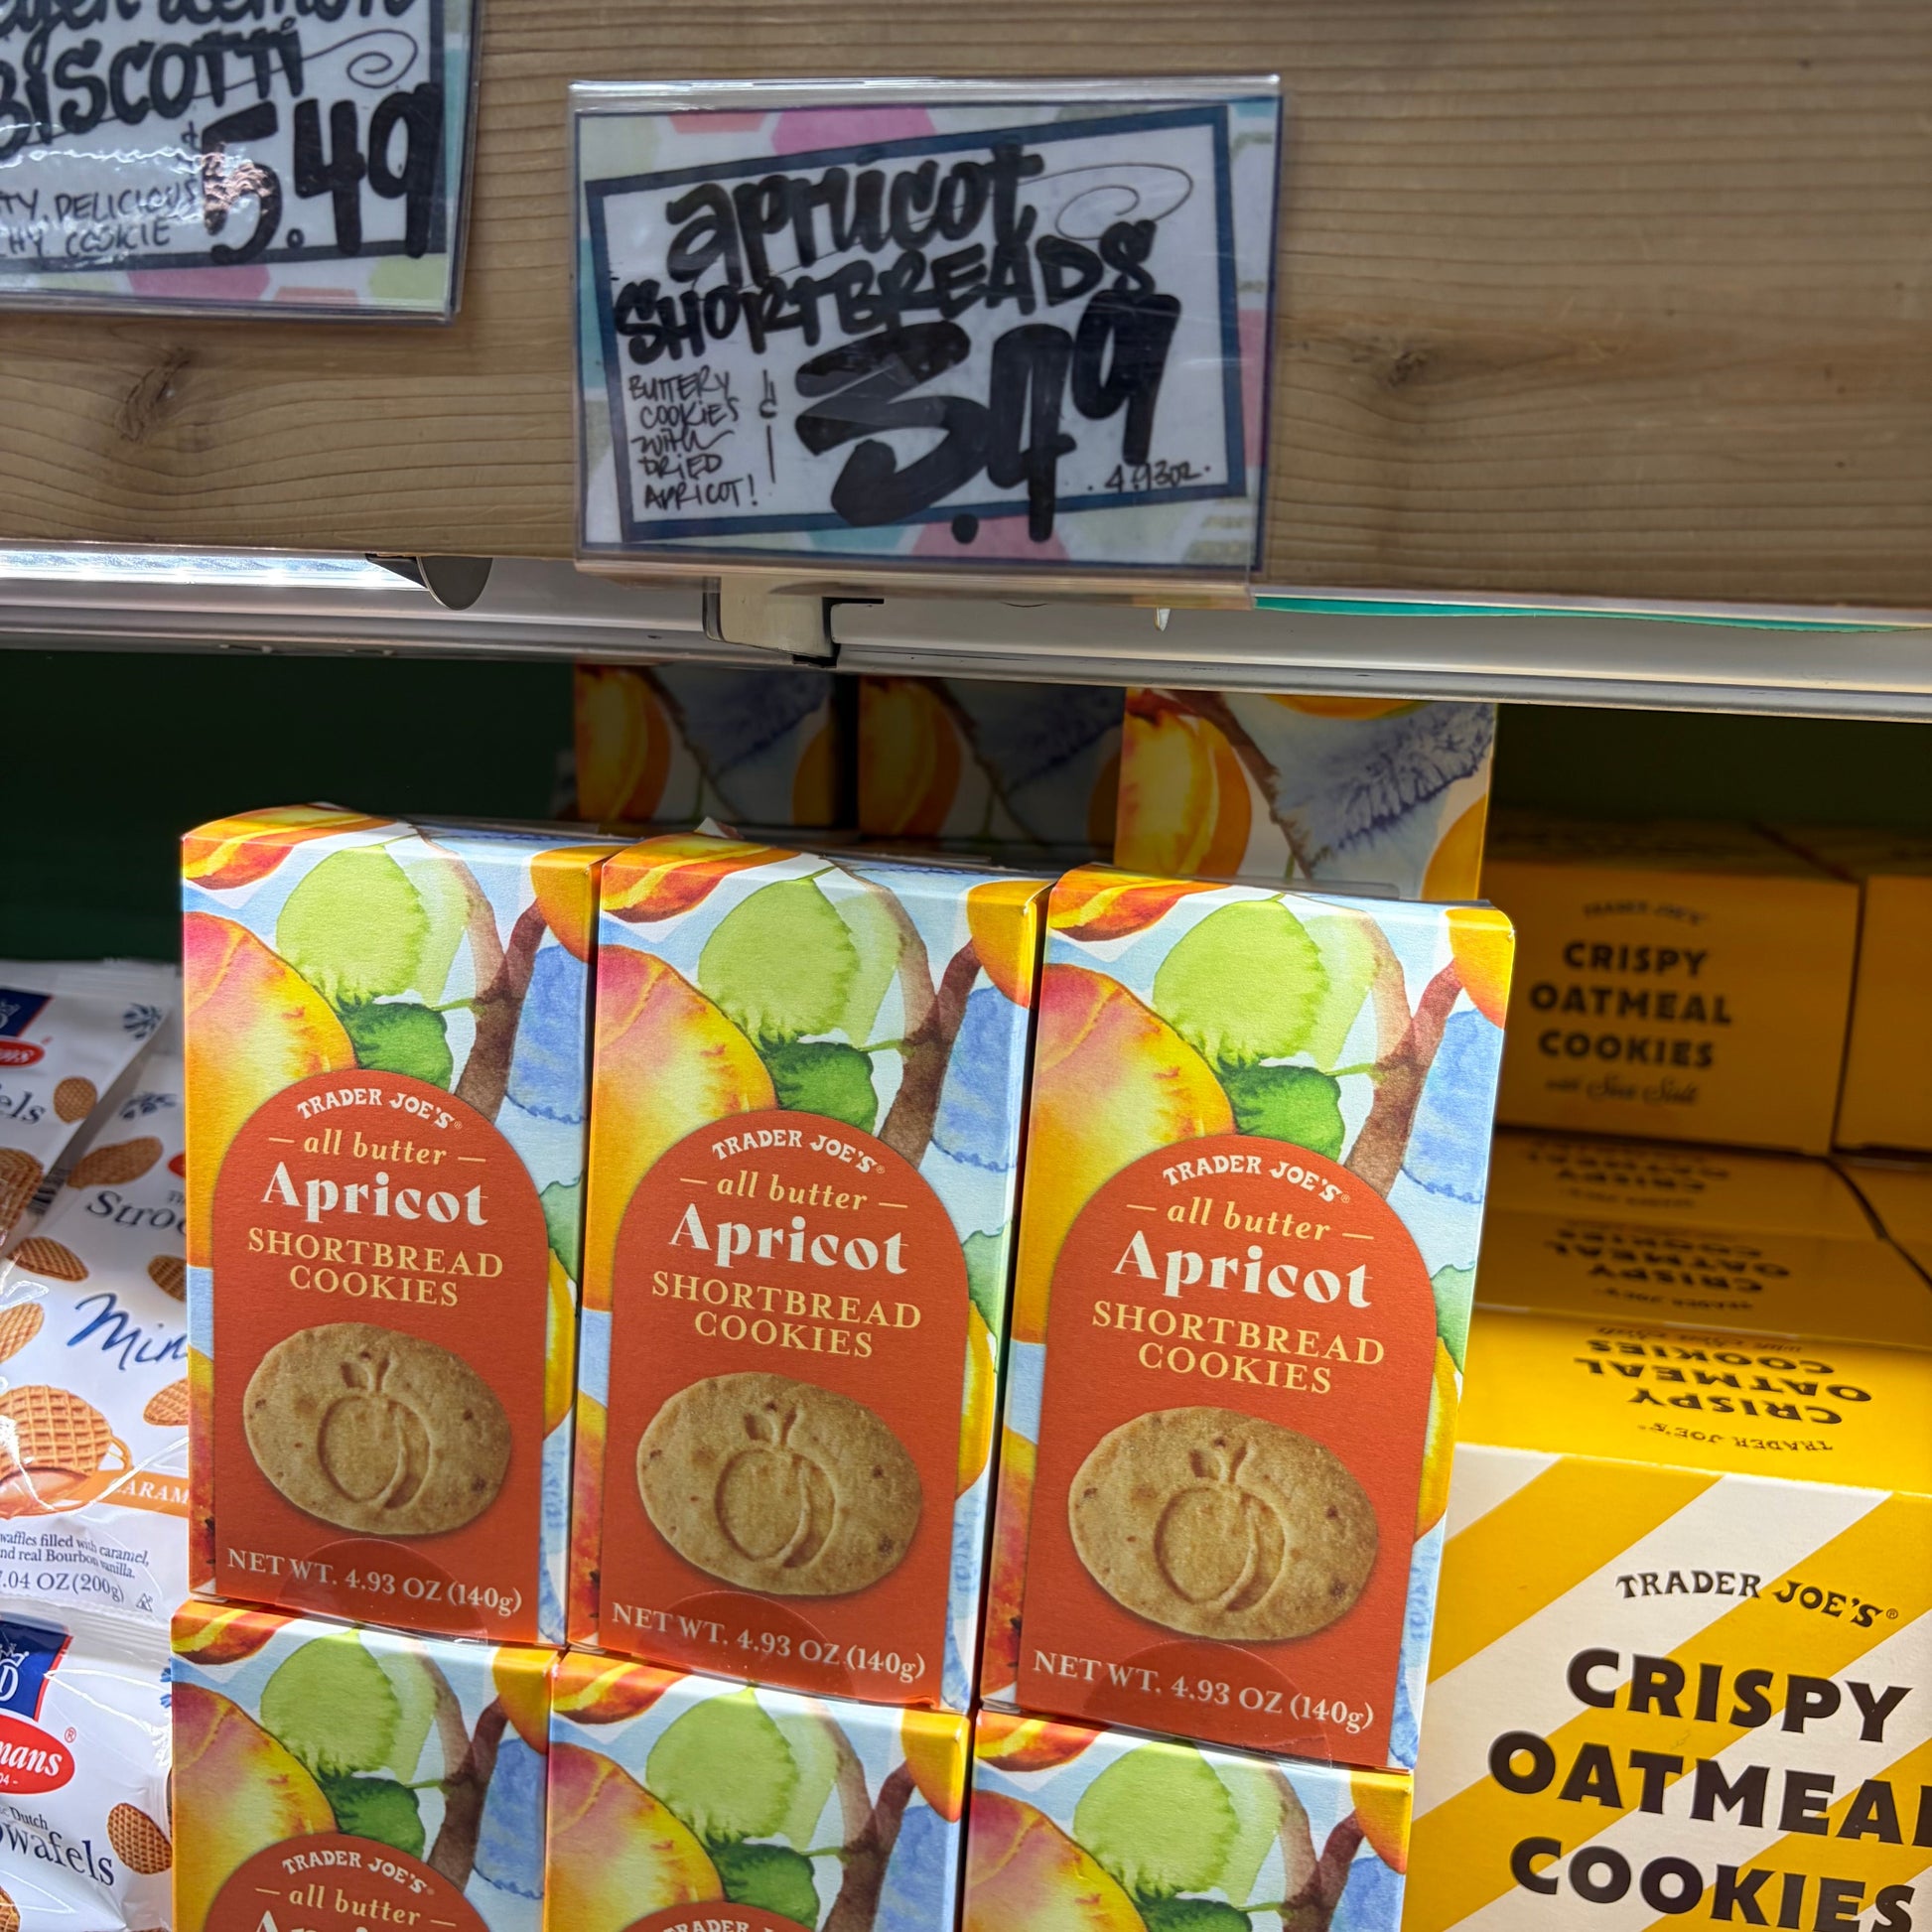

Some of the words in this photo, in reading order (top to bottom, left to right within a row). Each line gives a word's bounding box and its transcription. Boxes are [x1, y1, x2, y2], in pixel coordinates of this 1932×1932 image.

[66, 215, 170, 258] COOKIE
[629, 364, 730, 402] BUTTERY
[1564, 940, 1710, 976] CRISPY
[1529, 983, 1732, 1026] OATMEAL
[1538, 1030, 1716, 1069] COOKIES
[297, 1088, 382, 1121] TRADER
[304, 1129, 342, 1155] all
[353, 1132, 446, 1165] butter
[712, 1130, 802, 1161] TRADER
[717, 1171, 758, 1197] all
[769, 1174, 867, 1210] butter
[1163, 1155, 1262, 1186] TRADER
[261, 1162, 488, 1226] Apricot
[668, 1203, 908, 1275] Apricot
[1167, 1196, 1212, 1226] all
[1223, 1201, 1331, 1241] butter
[248, 1227, 503, 1279] SHORTBREAD
[1112, 1229, 1373, 1309] Apricot
[289, 1265, 458, 1308] COOKIES
[651, 1271, 921, 1329] SHORTBREAD
[694, 1311, 873, 1358] COOKIES
[1092, 1301, 1385, 1366] SHORTBREAD
[1138, 1342, 1331, 1394] COOKIES
[1587, 1339, 1835, 1374] COOKIES
[1574, 1357, 1871, 1402] OATMEAL
[1627, 1388, 1843, 1425] CRISPY
[1733, 1437, 1833, 1451] TRADER
[19, 1550, 42, 1562] real
[46, 1549, 99, 1567] Bourbon
[41, 1534, 73, 1547] filled
[76, 1539, 97, 1553] with
[227, 1548, 285, 1575] NET
[289, 1559, 338, 1586] WT.
[345, 1569, 395, 1594] 4.93
[403, 1577, 442, 1601] OZ
[447, 1581, 522, 1616] (140g)
[1616, 1569, 1761, 1599] TRADER
[612, 1602, 672, 1632] NET
[677, 1615, 728, 1645] WT.
[736, 1629, 790, 1657] 4.93
[799, 1639, 840, 1665] OZ
[846, 1644, 925, 1683] (140g)
[1033, 1649, 1103, 1680] NET
[1107, 1662, 1162, 1694] WT.
[1171, 1676, 1230, 1705] 4.93
[1238, 1688, 1283, 1715] OZ
[1290, 1692, 1374, 1734] (140g)
[1567, 1646, 1913, 1743] CRISPY
[9, 1806, 48, 1831] Dutch
[0, 1823, 114, 1886] wafels
[282, 1851, 362, 1874] TRADER
[289, 1884, 326, 1909] all
[335, 1888, 421, 1926] butter
[1509, 1836, 1915, 1932] COOKIES
